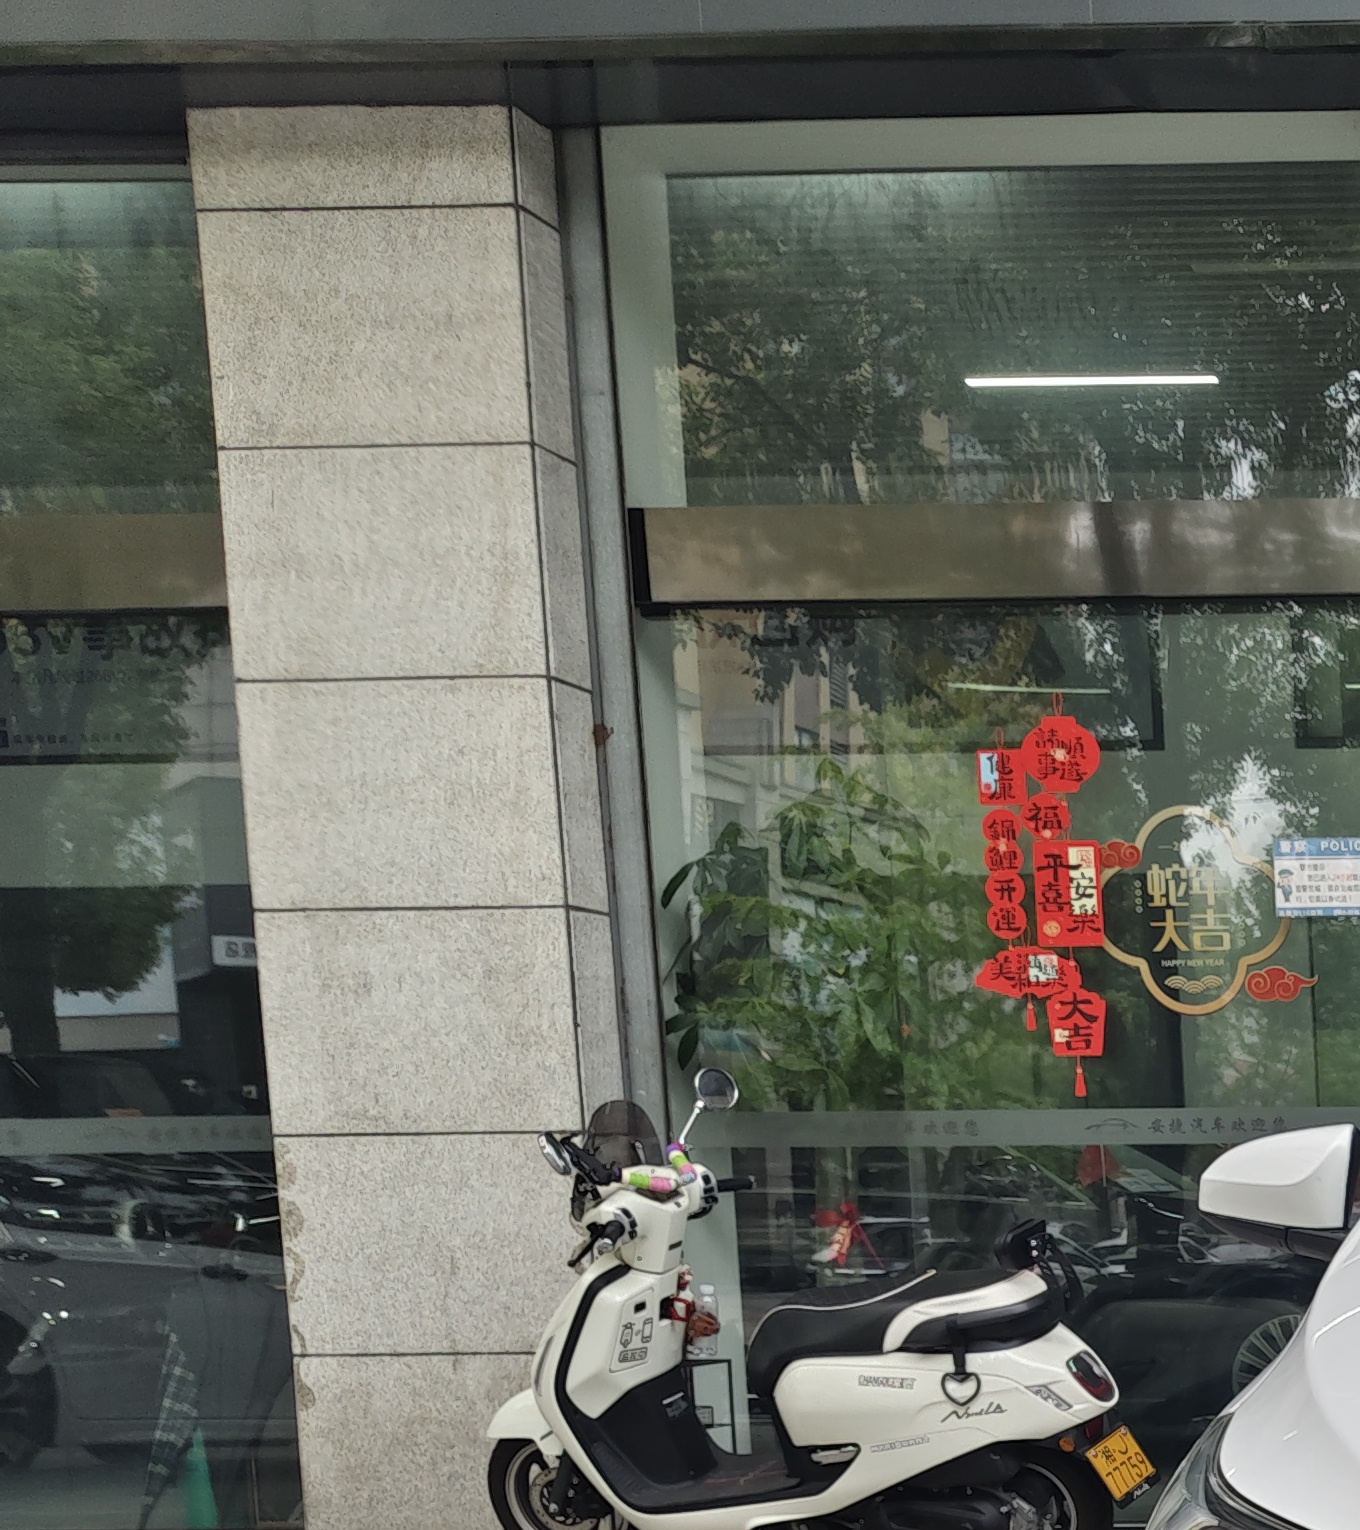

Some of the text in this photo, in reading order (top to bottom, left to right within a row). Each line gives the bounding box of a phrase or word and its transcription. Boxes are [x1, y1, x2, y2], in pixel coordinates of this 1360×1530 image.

[1024, 802, 1063, 833] 福
[1146, 863, 1230, 907] 蛇年
[1150, 908, 1231, 953] 大吉
[1161, 958, 1225, 968] HAPPY NEW YEAR
[1058, 992, 1100, 1051] 大吉
[1147, 1115, 1289, 1136] 安捷汽车欢迎您
[1105, 1452, 1149, 1495] 77759
